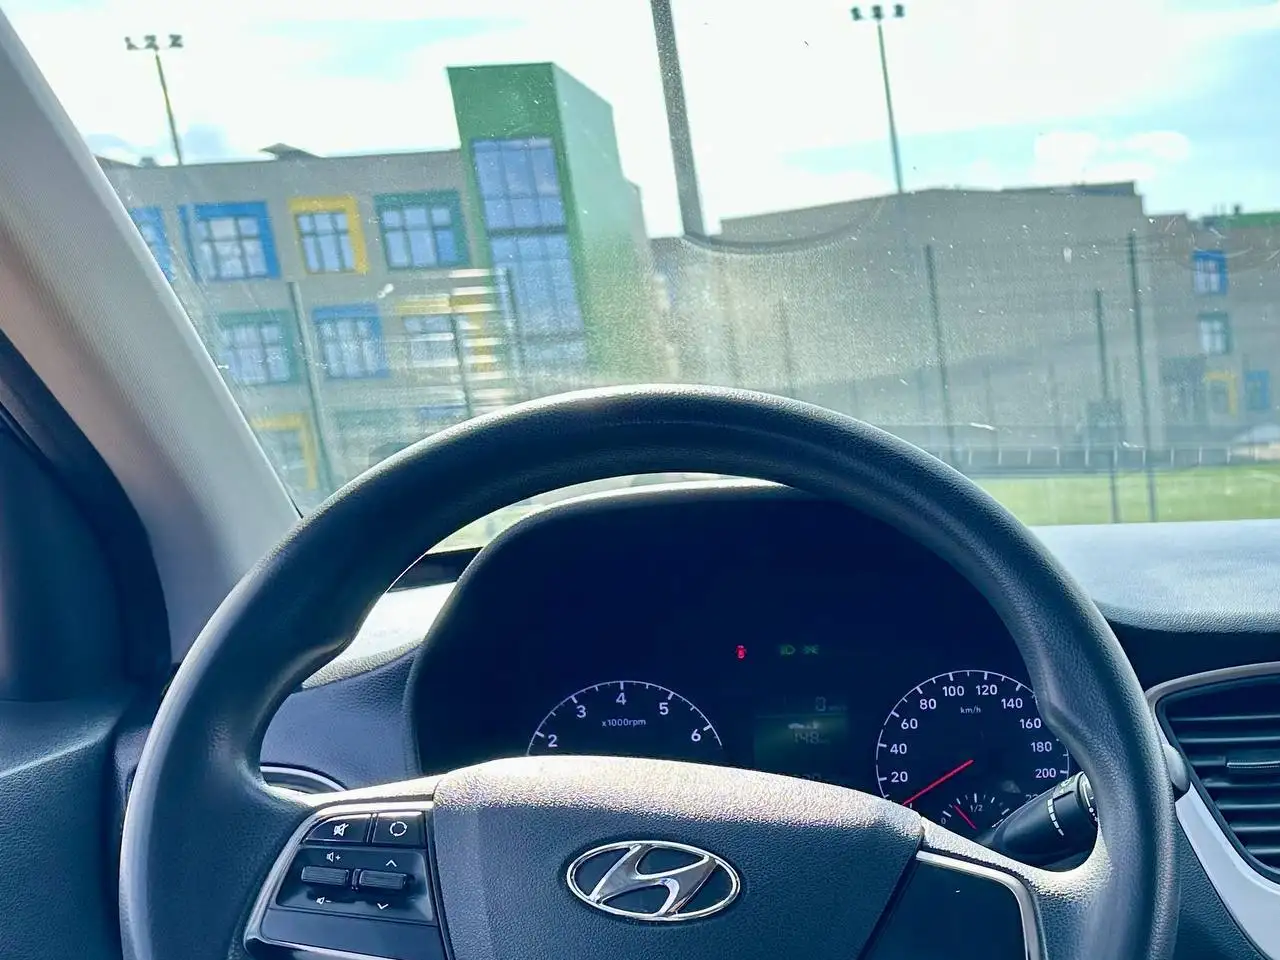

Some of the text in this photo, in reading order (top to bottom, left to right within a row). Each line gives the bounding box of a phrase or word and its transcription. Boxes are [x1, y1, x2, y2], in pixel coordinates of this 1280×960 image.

[942, 686, 965, 697] 100
[976, 684, 998, 695] 120
[615, 692, 627, 705] 4
[919, 698, 937, 710] 80
[1001, 698, 1023, 709] 140
[576, 705, 587, 719] 3
[659, 702, 669, 715] 5
[960, 706, 981, 714] km/h
[602, 718, 647, 728] x1000rpm
[901, 718, 918, 730] 60
[1019, 718, 1042, 729] 160
[548, 734, 558, 748] 2
[691, 728, 701, 742] 6
[890, 742, 908, 755] 40
[1030, 741, 1053, 753] 180
[890, 771, 909, 783] 20
[1035, 767, 1057, 779] 200
[970, 804, 983, 812] 1/2
